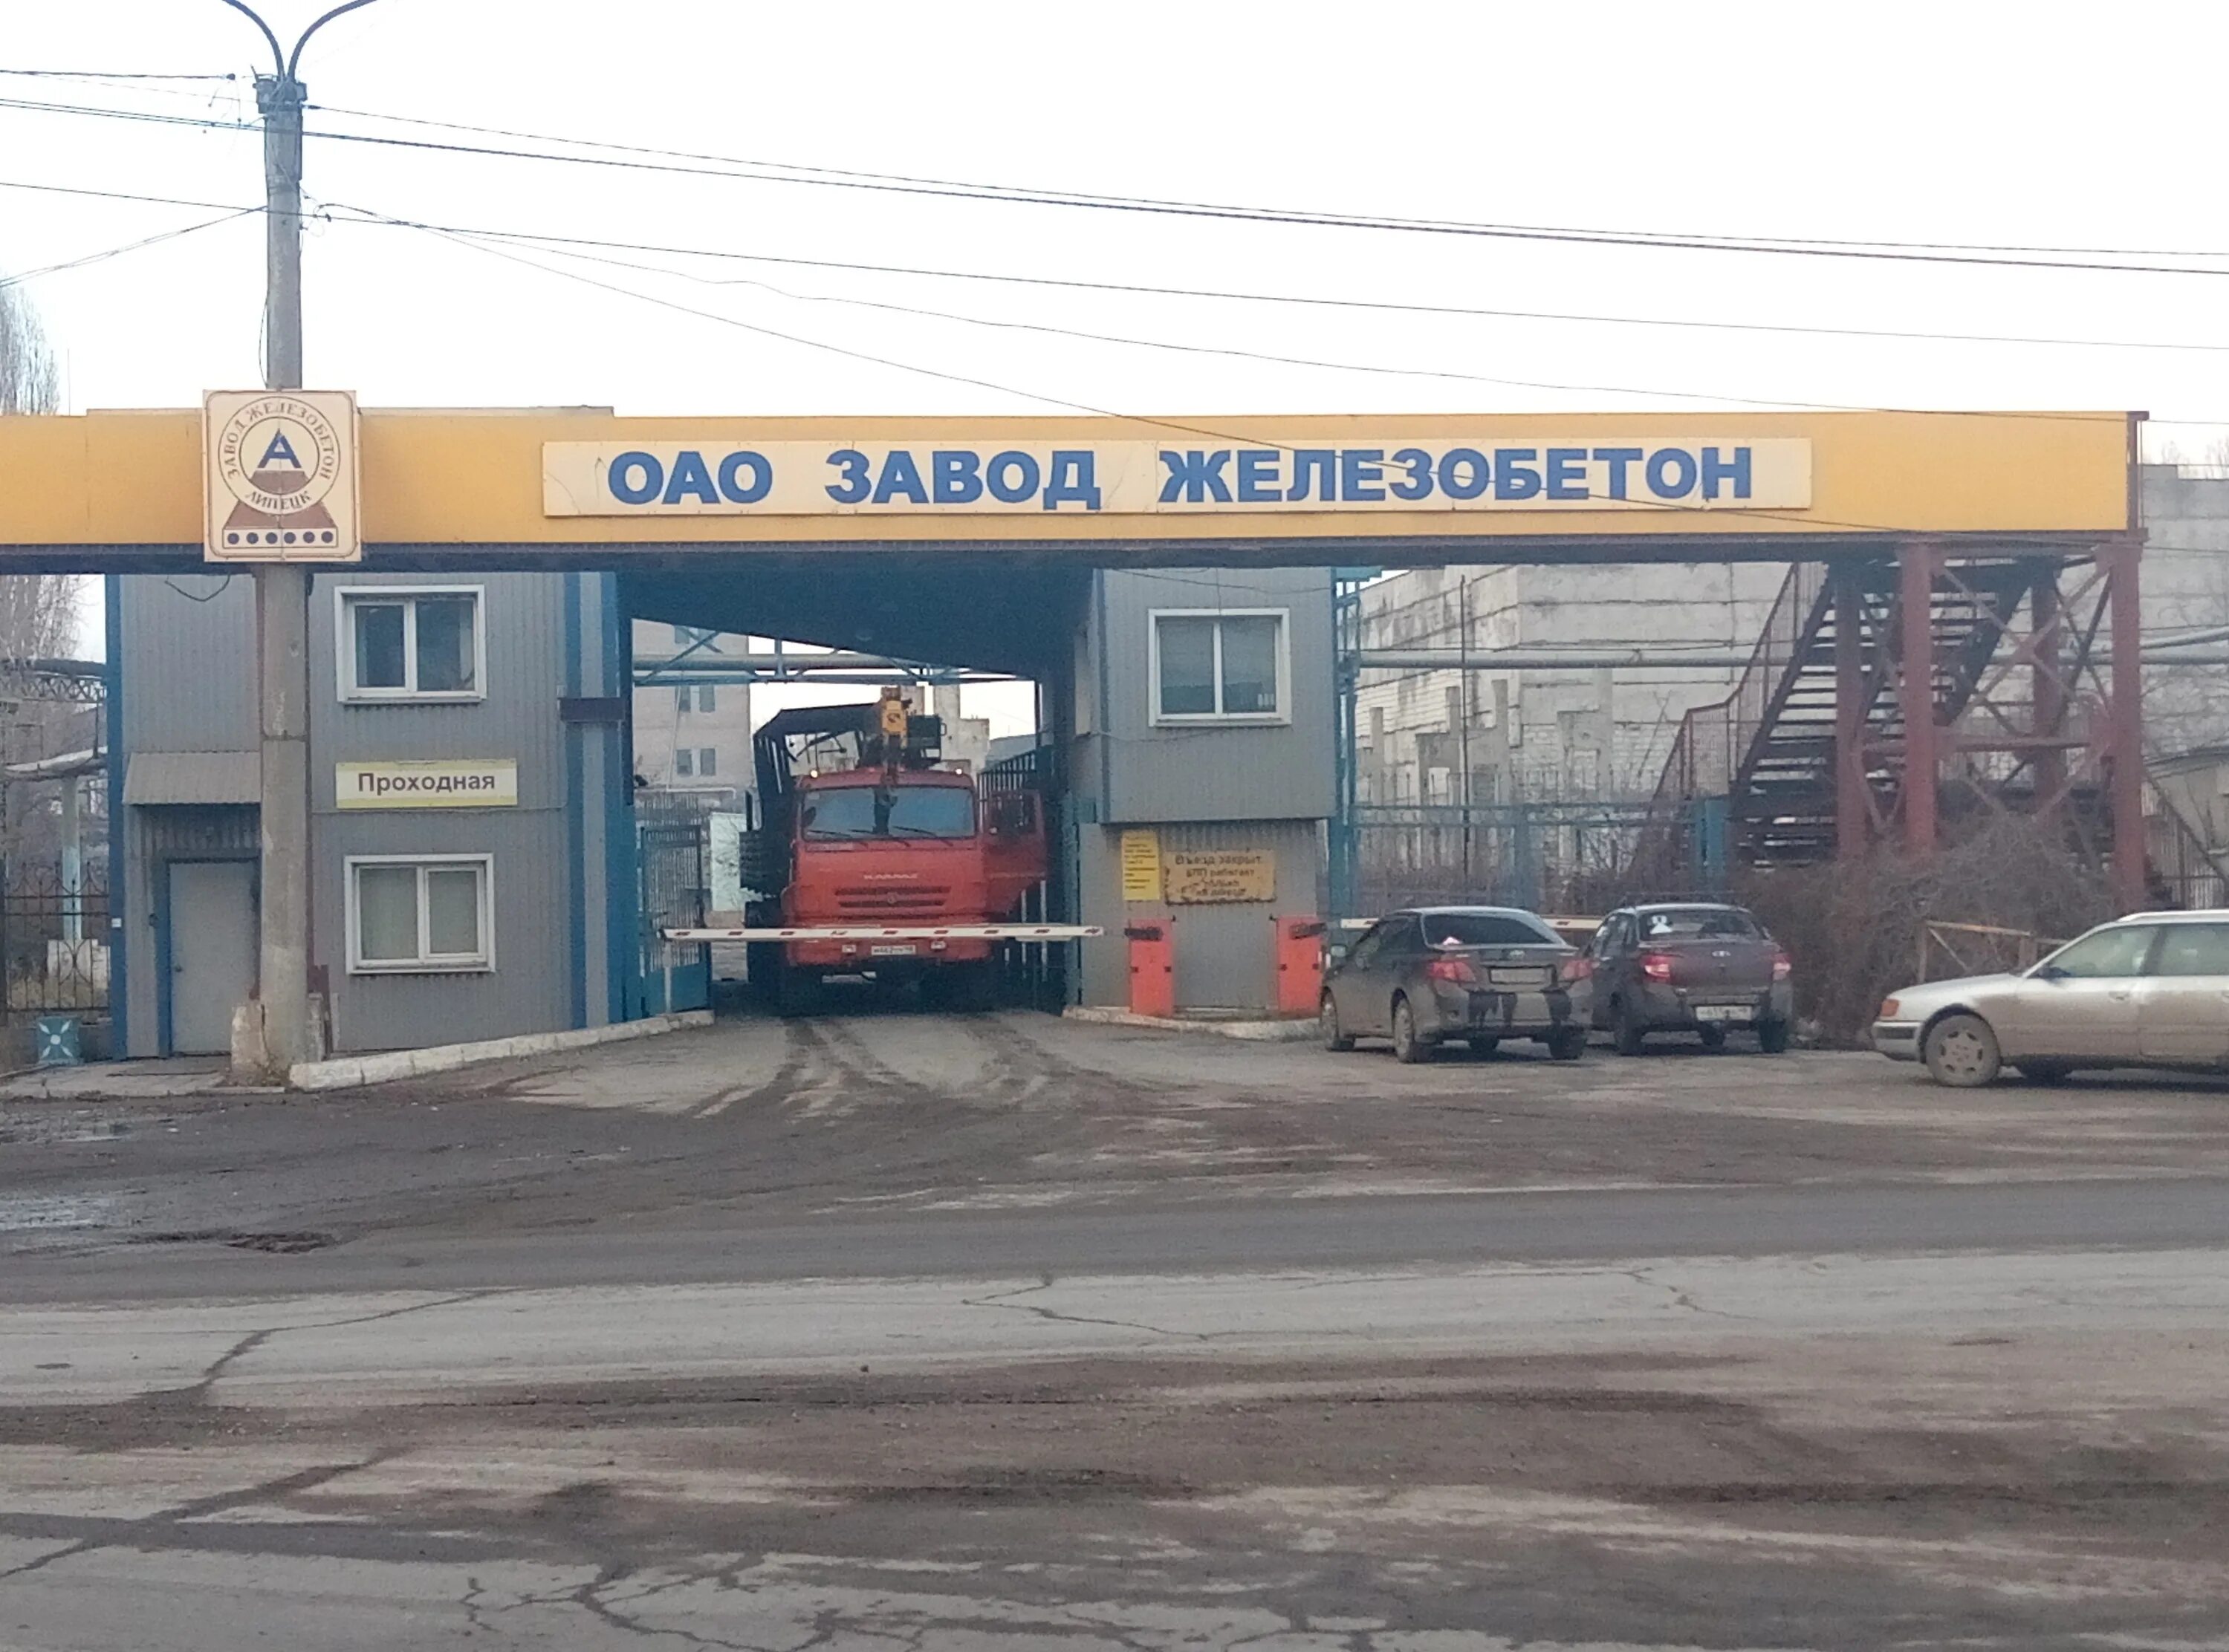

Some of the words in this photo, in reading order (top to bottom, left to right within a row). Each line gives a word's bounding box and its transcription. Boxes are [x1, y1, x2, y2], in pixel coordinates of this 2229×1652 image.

[608, 450, 773, 504] ОАО
[824, 449, 1101, 511] ЗАВОД
[1158, 447, 1751, 503] ЖЕЛЕЗОБЕТОН
[245, 490, 312, 510] ЛИПЕЦК
[357, 773, 496, 796] Проходная
